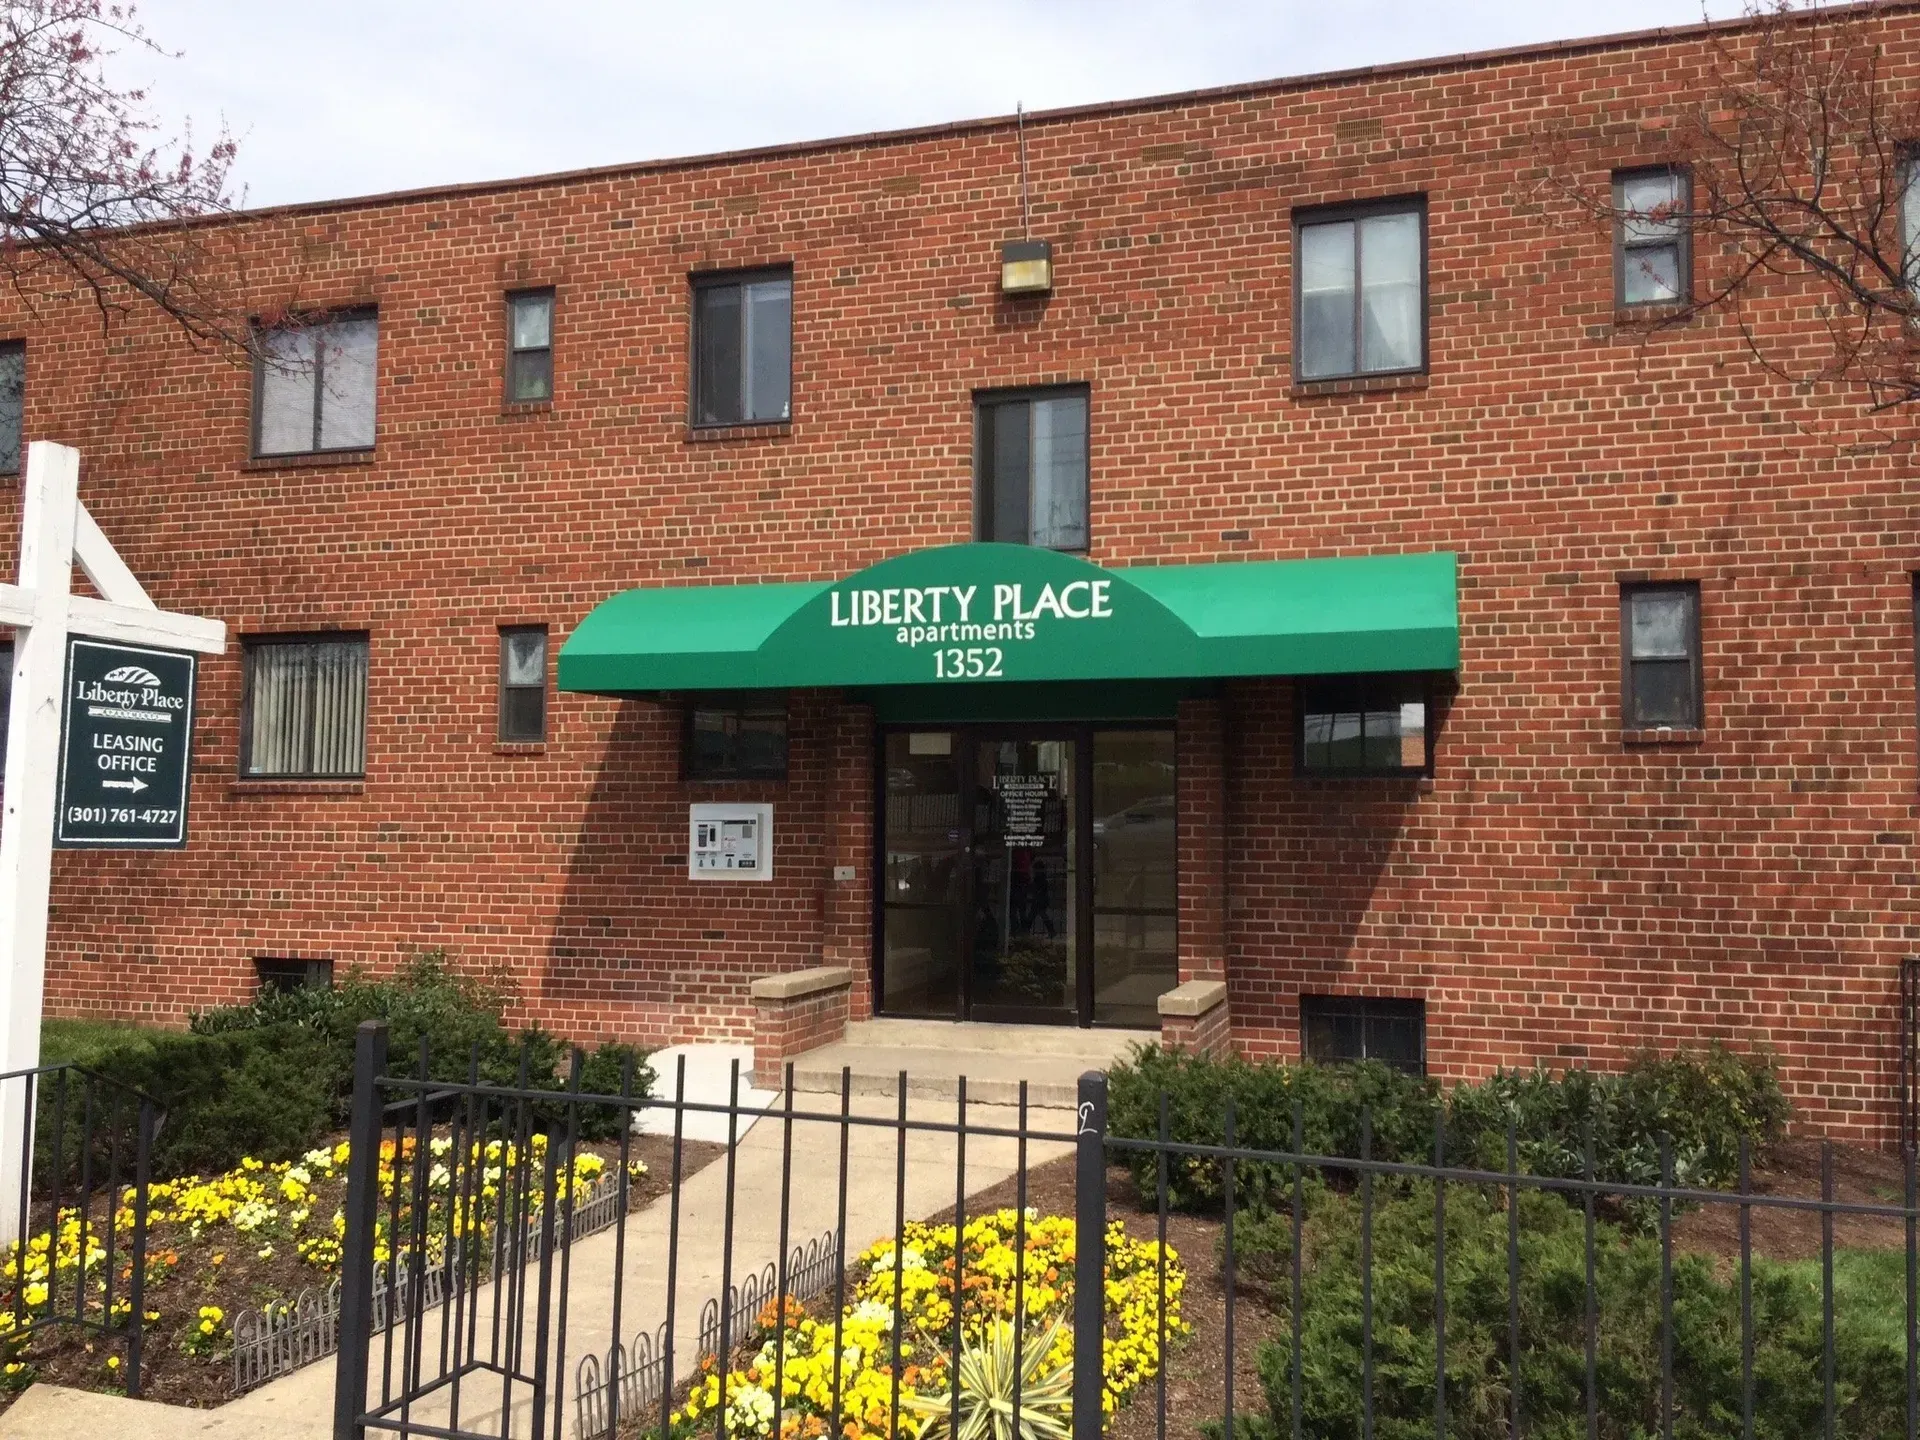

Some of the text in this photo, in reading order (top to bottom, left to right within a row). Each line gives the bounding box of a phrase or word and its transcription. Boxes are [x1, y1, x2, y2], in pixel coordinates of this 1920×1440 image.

[830, 580, 1113, 626] LIBERTY PLACE
[896, 620, 1036, 648] apartments
[932, 647, 1003, 678] 1352
[76, 680, 184, 711] Liberty Place
[93, 733, 164, 753] LEASING
[97, 754, 157, 772] OFFICE
[67, 806, 178, 824] (301) 761-4727
